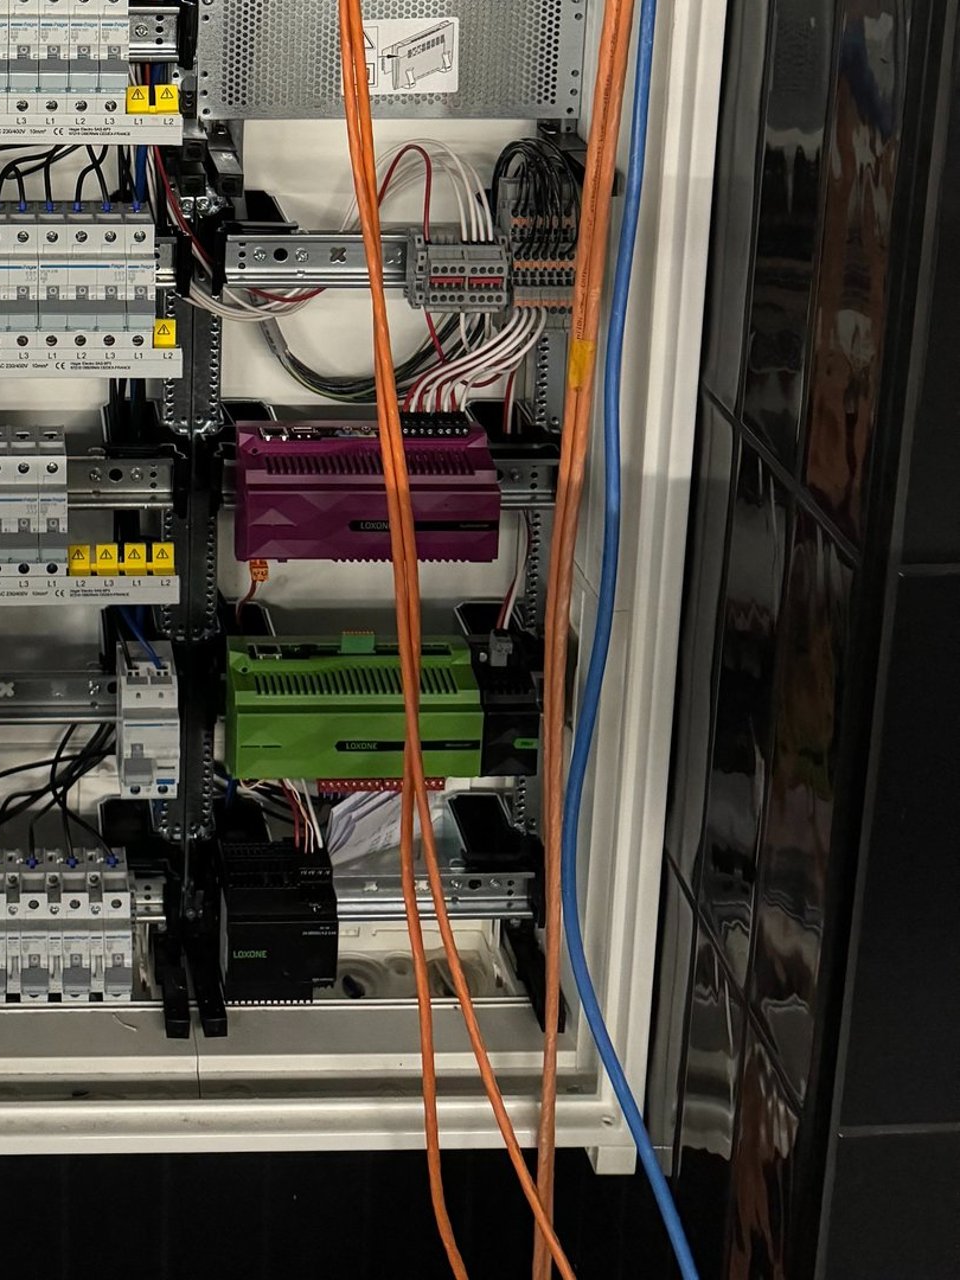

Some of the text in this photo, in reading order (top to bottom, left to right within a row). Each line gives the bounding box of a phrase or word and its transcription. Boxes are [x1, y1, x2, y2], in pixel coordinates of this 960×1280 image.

[360, 522, 391, 530] LOXON
[345, 742, 377, 750] LOXONE
[233, 950, 267, 958] LOXONE
